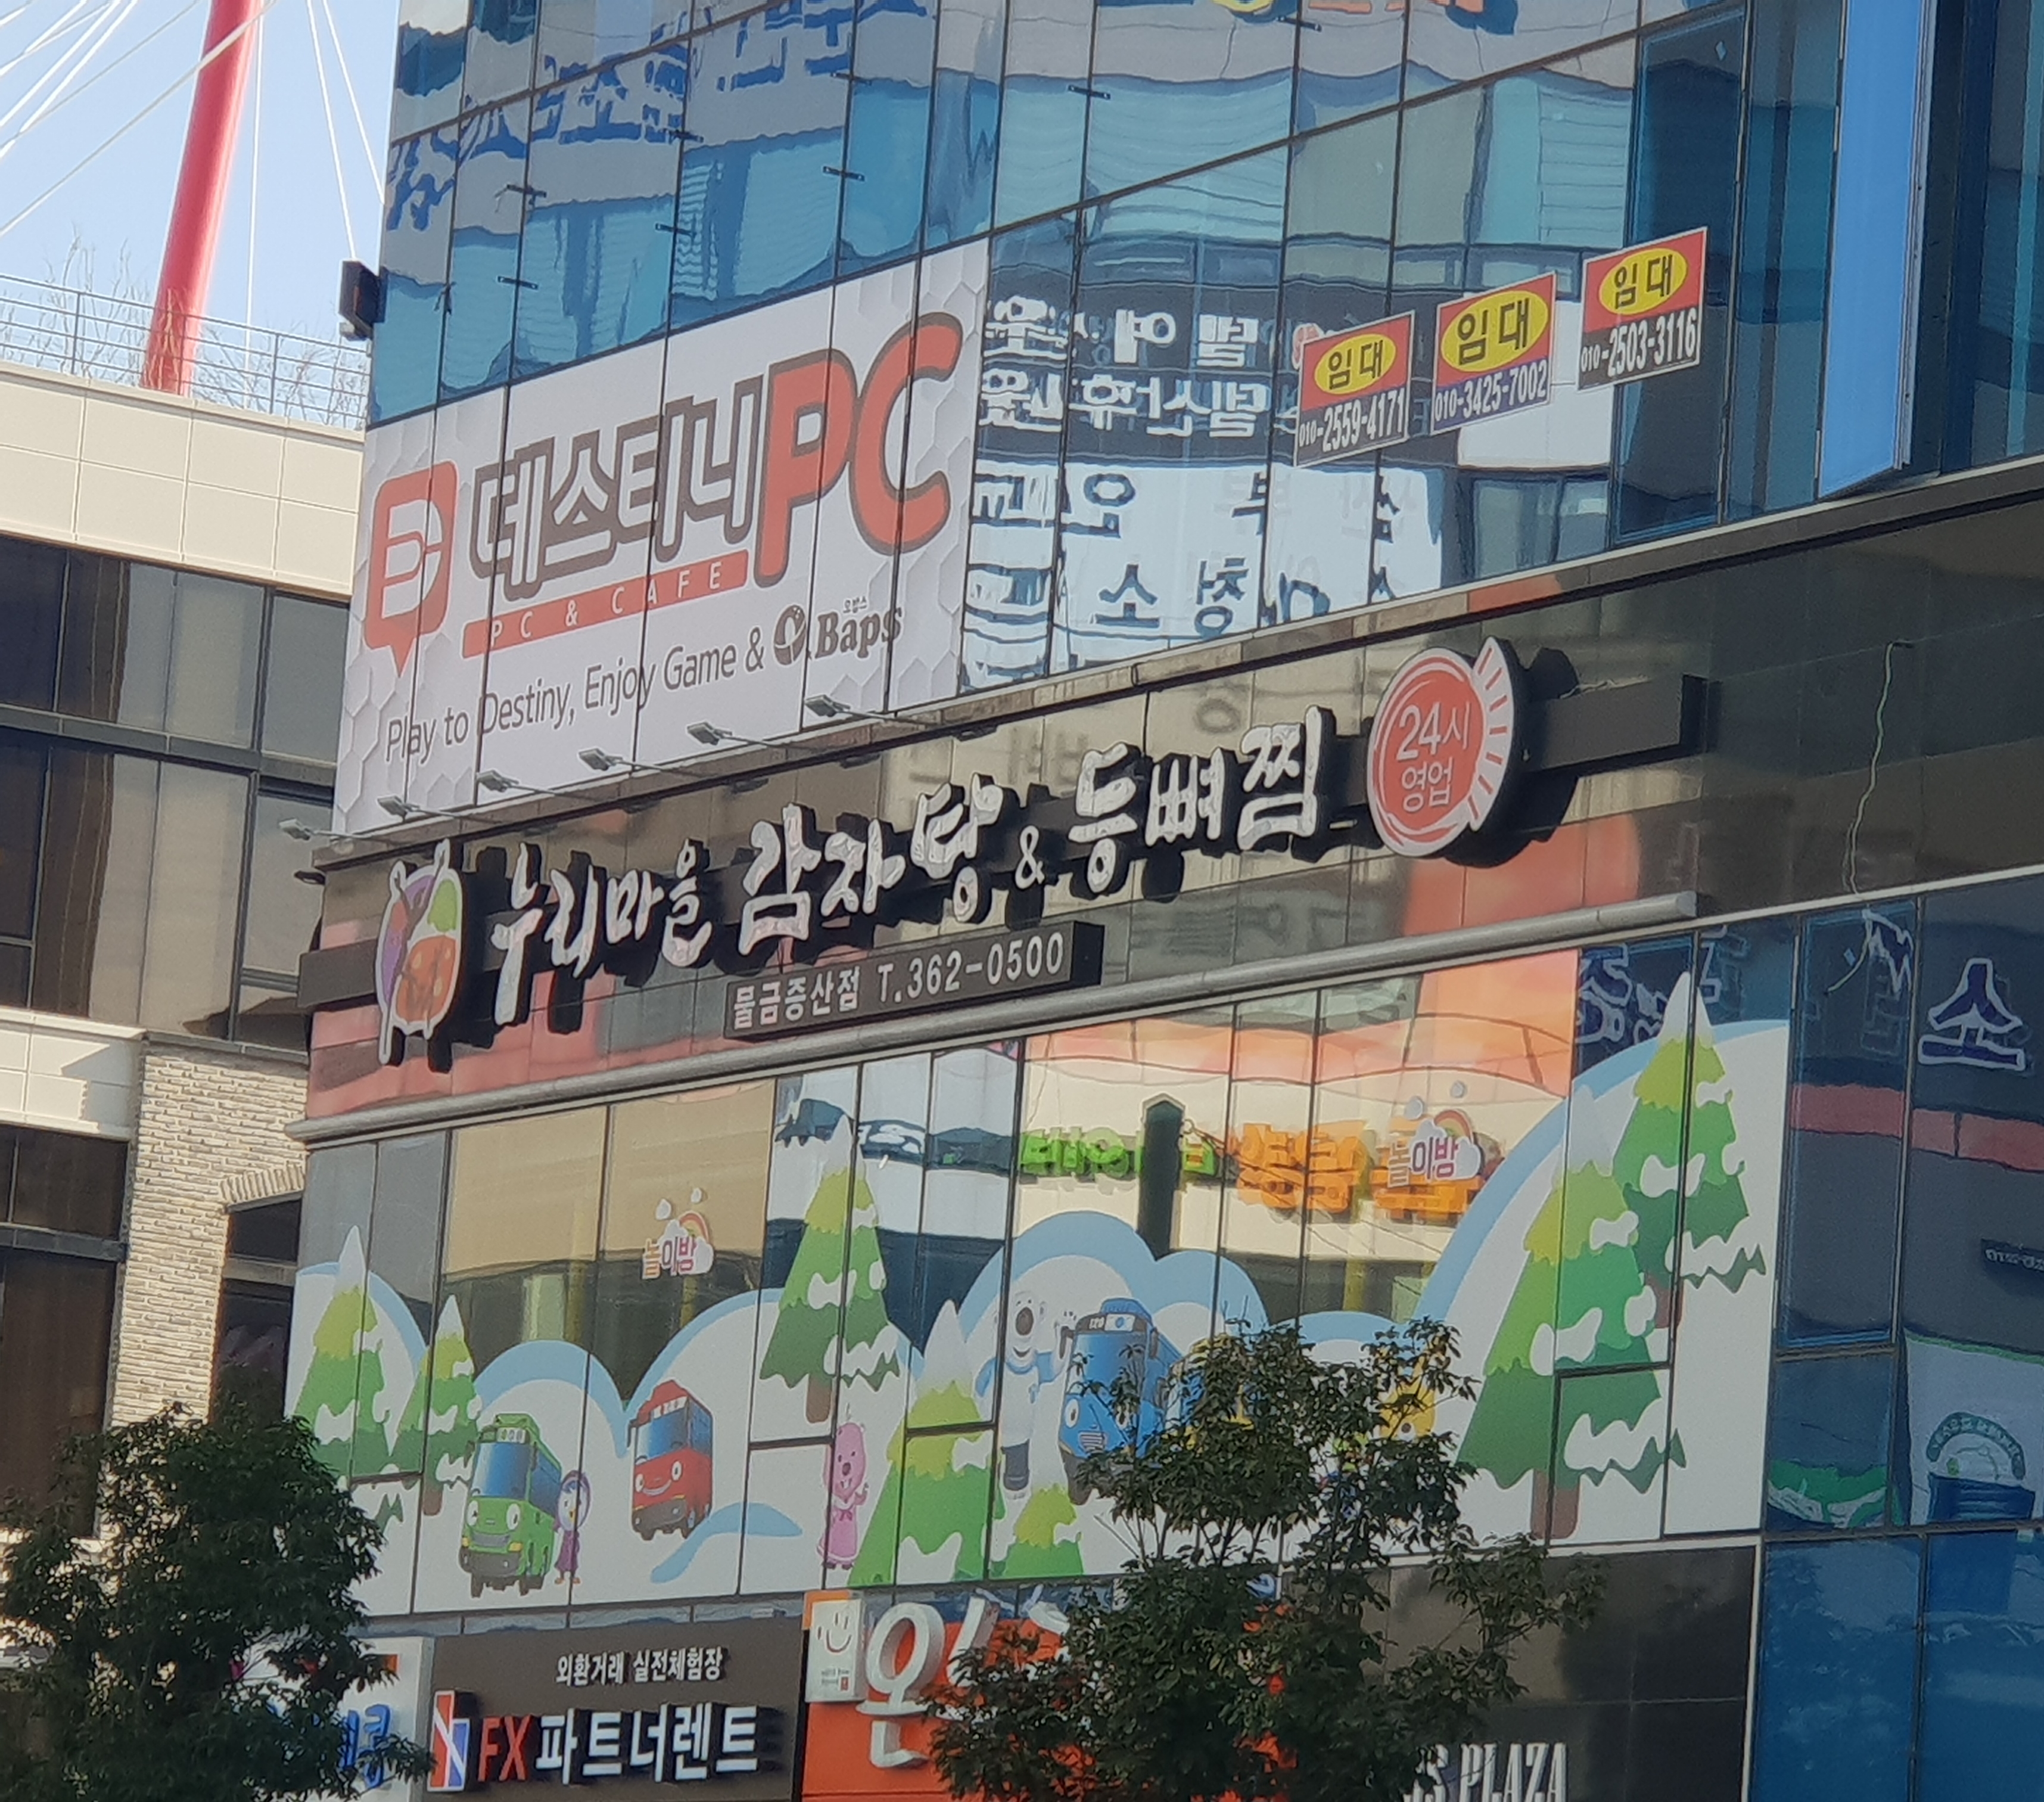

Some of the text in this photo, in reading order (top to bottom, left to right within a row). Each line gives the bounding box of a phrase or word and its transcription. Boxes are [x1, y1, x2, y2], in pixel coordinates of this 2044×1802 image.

[1614, 254, 1672, 310] 임대
[1457, 298, 1529, 365] 임대
[1581, 307, 1697, 377] 010-2503-3116
[1328, 340, 1383, 390] 임대
[1434, 359, 1547, 422] 010-3425-7002
[1299, 387, 1405, 452] 010-2559-4171
[490, 562, 721, 647] PC & CAFE
[387, 715, 436, 765] Play
[444, 707, 469, 745] to
[478, 679, 575, 736] Destiny,
[585, 657, 656, 715] Enjoy
[664, 644, 736, 691] Game
[745, 626, 764, 672] &
[1396, 701, 1471, 761] 24시
[1401, 756, 1454, 813] 영업
[490, 705, 1323, 1026] 누리마을 감자탕 & 등뼈찜
[733, 931, 1065, 1030] 물금증산점 T.362-0500
[1387, 1135, 1459, 1187] 놀이방
[642, 1236, 698, 1277] 놀이방
[555, 1646, 723, 1687] 외환거래 실전체험장
[1460, 1741, 1567, 1802] PLAZA
